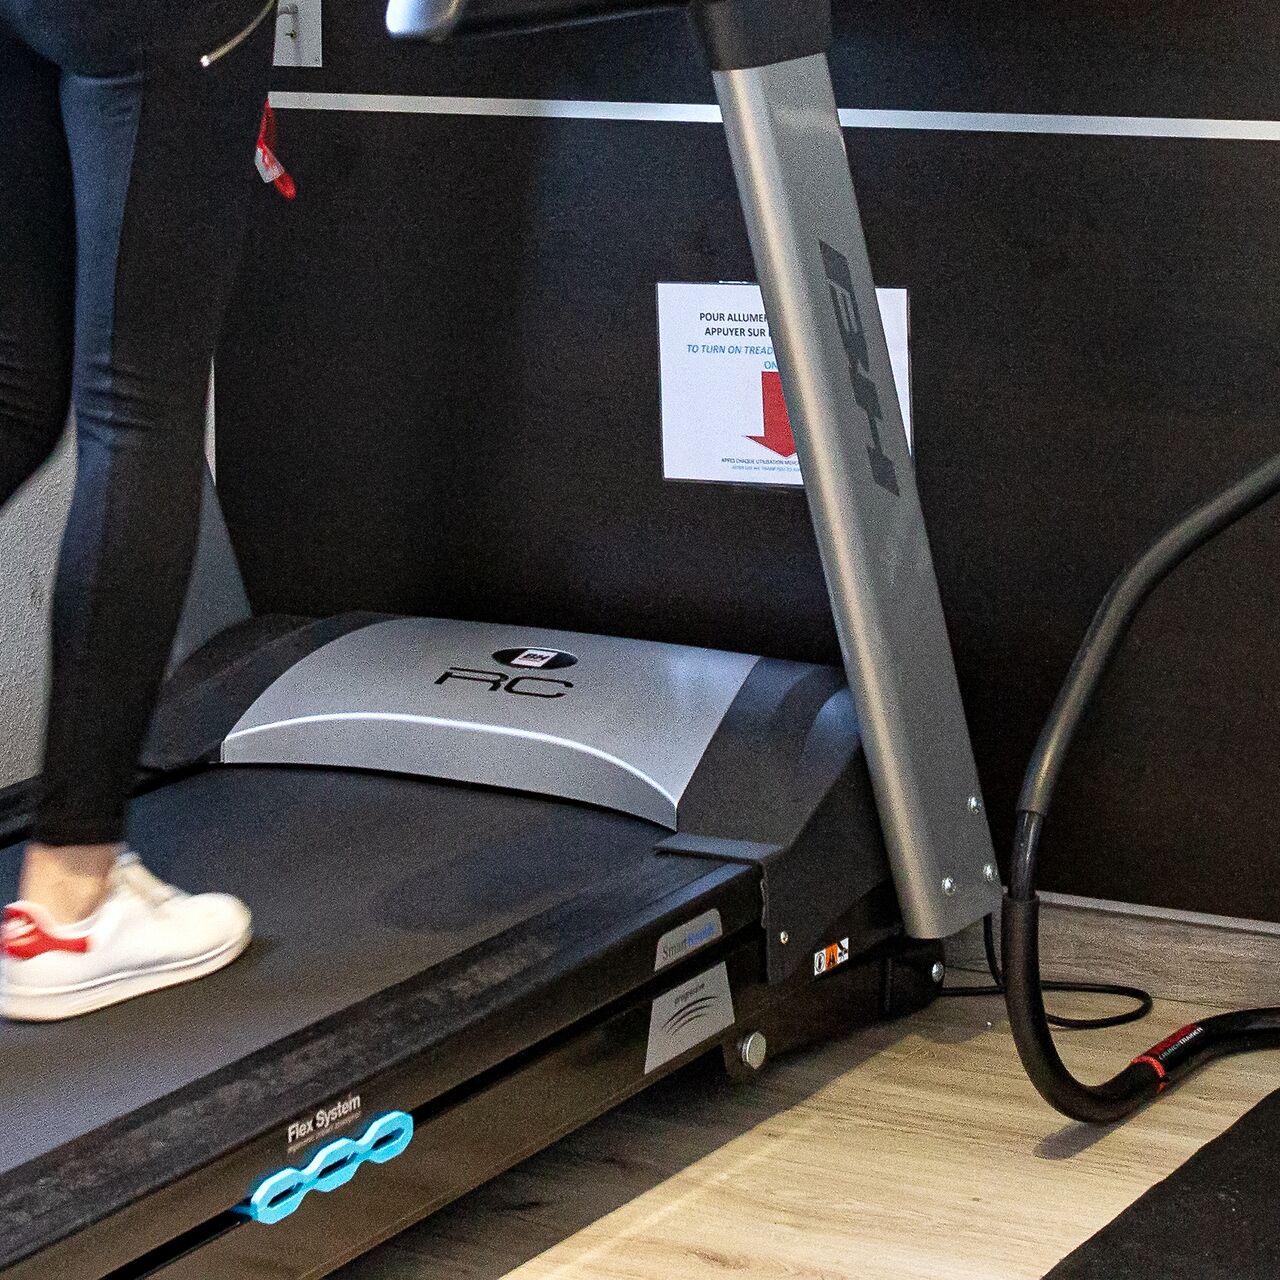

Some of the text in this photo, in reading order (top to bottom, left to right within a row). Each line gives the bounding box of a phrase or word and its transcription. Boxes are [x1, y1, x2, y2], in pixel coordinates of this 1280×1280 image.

[700, 312, 725, 322] POUR
[705, 327, 766, 337] APPUYER SUR
[687, 344, 699, 354] TO
[701, 344, 725, 354] TURN
[728, 345, 741, 354] ON
[287, 1120, 313, 1144] Flex
[316, 1095, 361, 1128] System
